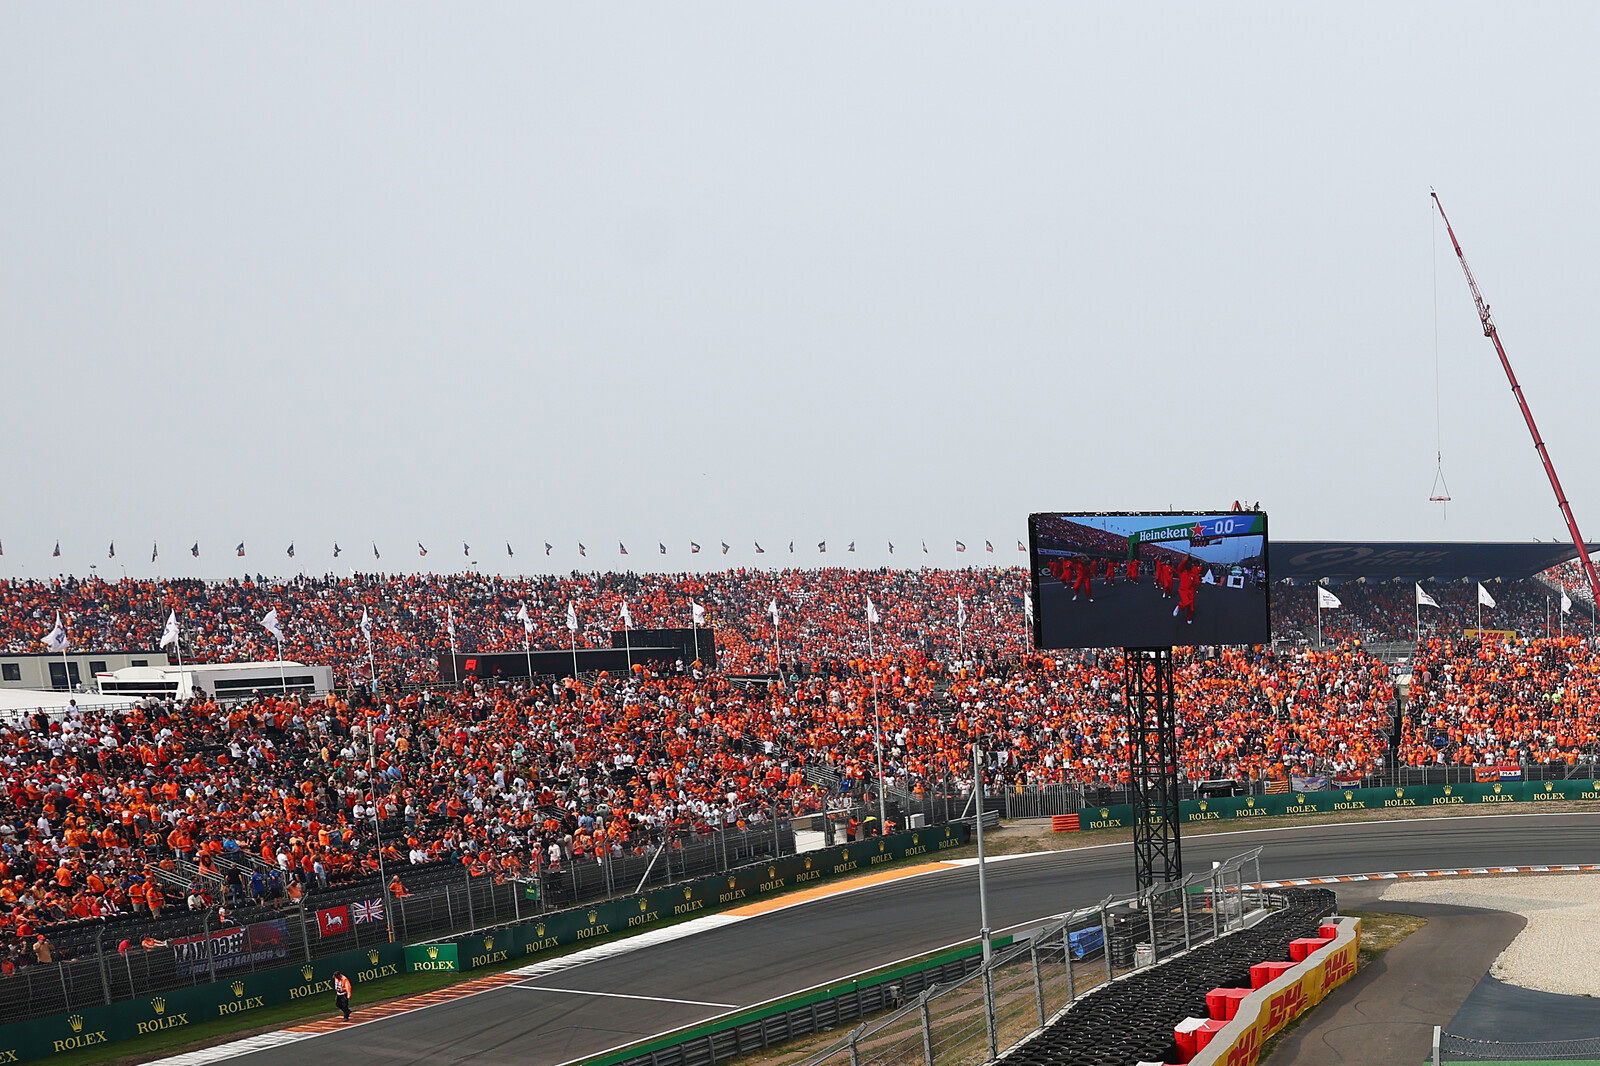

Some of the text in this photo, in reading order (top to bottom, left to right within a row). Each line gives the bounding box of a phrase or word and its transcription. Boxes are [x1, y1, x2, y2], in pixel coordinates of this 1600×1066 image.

[1139, 526, 1189, 542] Heineken
[1384, 798, 1417, 807] ROLEX
[1432, 796, 1464, 804] ROLEX
[1482, 794, 1514, 802] ROLEX
[1533, 791, 1565, 801] ROLEX
[1235, 807, 1268, 817] ROLEX
[1286, 804, 1318, 814] ROLEX
[1334, 800, 1366, 810] ROLEX
[1089, 817, 1122, 830] ROLEX
[1189, 811, 1221, 822] ROLEX
[904, 844, 927, 857] ROLEX
[938, 837, 960, 850] ROLEX
[870, 851, 893, 865] ROLEX
[834, 859, 857, 874] ROLEX
[796, 868, 821, 883] ROLEX
[759, 877, 785, 893] ROLEX
[719, 887, 746, 903] ROLEX
[674, 898, 704, 914] ROLEX
[628, 909, 659, 927] ROLEX
[576, 922, 609, 941] ROLEX
[525, 935, 559, 954] ROLEX
[414, 960, 455, 971] ROLEX
[471, 949, 509, 968] ROLEX
[357, 962, 399, 983] ROLEX
[1323, 948, 1350, 988] DHL
[289, 979, 335, 1000] ROLEX
[218, 995, 265, 1016] ROLEX
[1267, 980, 1303, 1029] DHL
[137, 1012, 190, 1035] ROLEX
[53, 1030, 108, 1053] ROLEX
